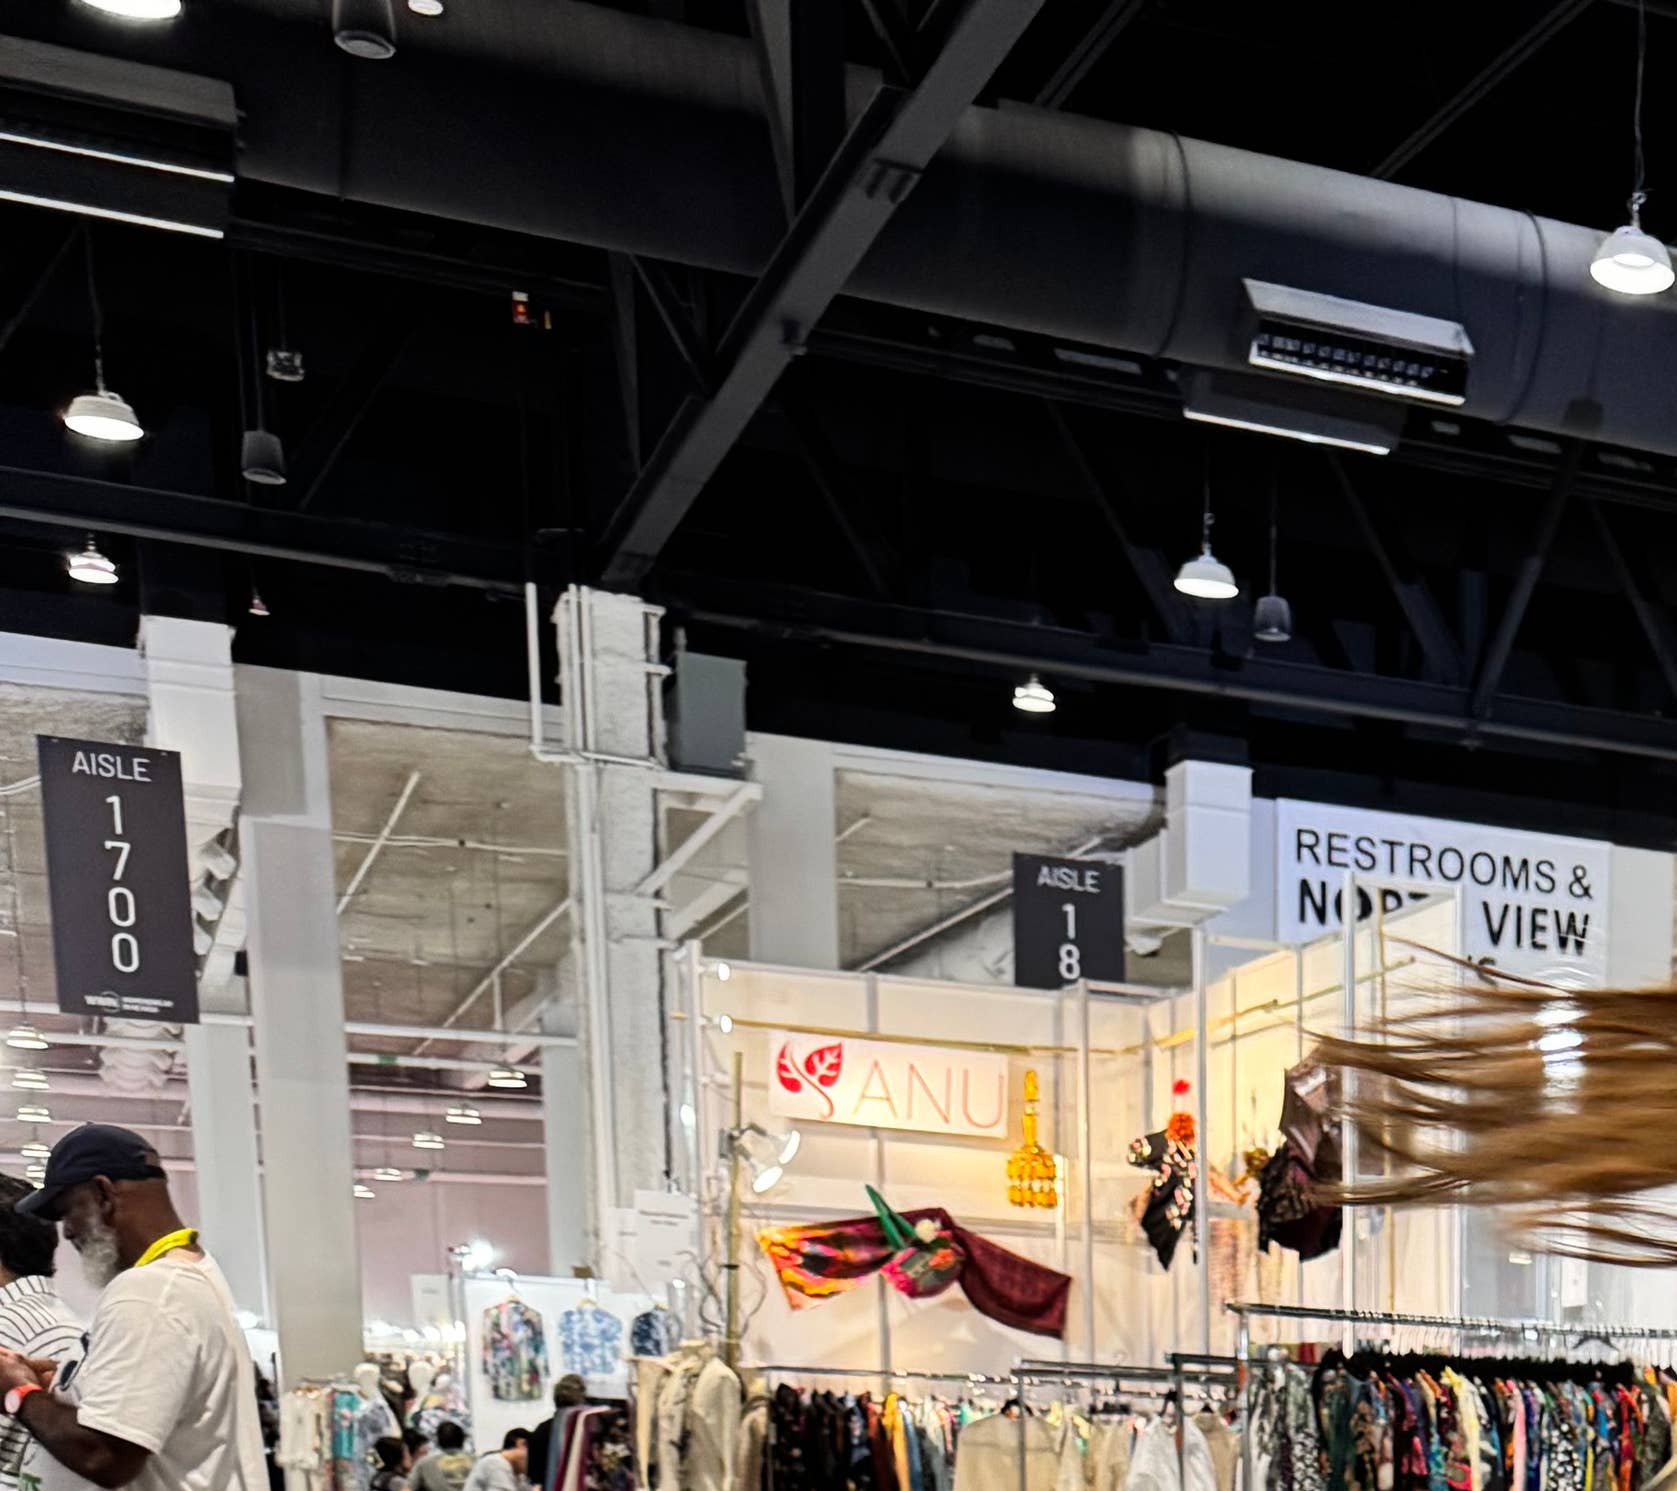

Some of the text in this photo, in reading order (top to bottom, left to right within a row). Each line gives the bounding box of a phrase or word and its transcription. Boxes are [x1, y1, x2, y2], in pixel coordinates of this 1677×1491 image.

[72, 750, 151, 782] AISLE
[104, 795, 140, 972] 1700
[1037, 865, 1101, 894] AISLE
[1295, 828, 1593, 900] RESTROOMS &
[1482, 900, 1590, 956] VIEW
[852, 1058, 1005, 1130] ANU
